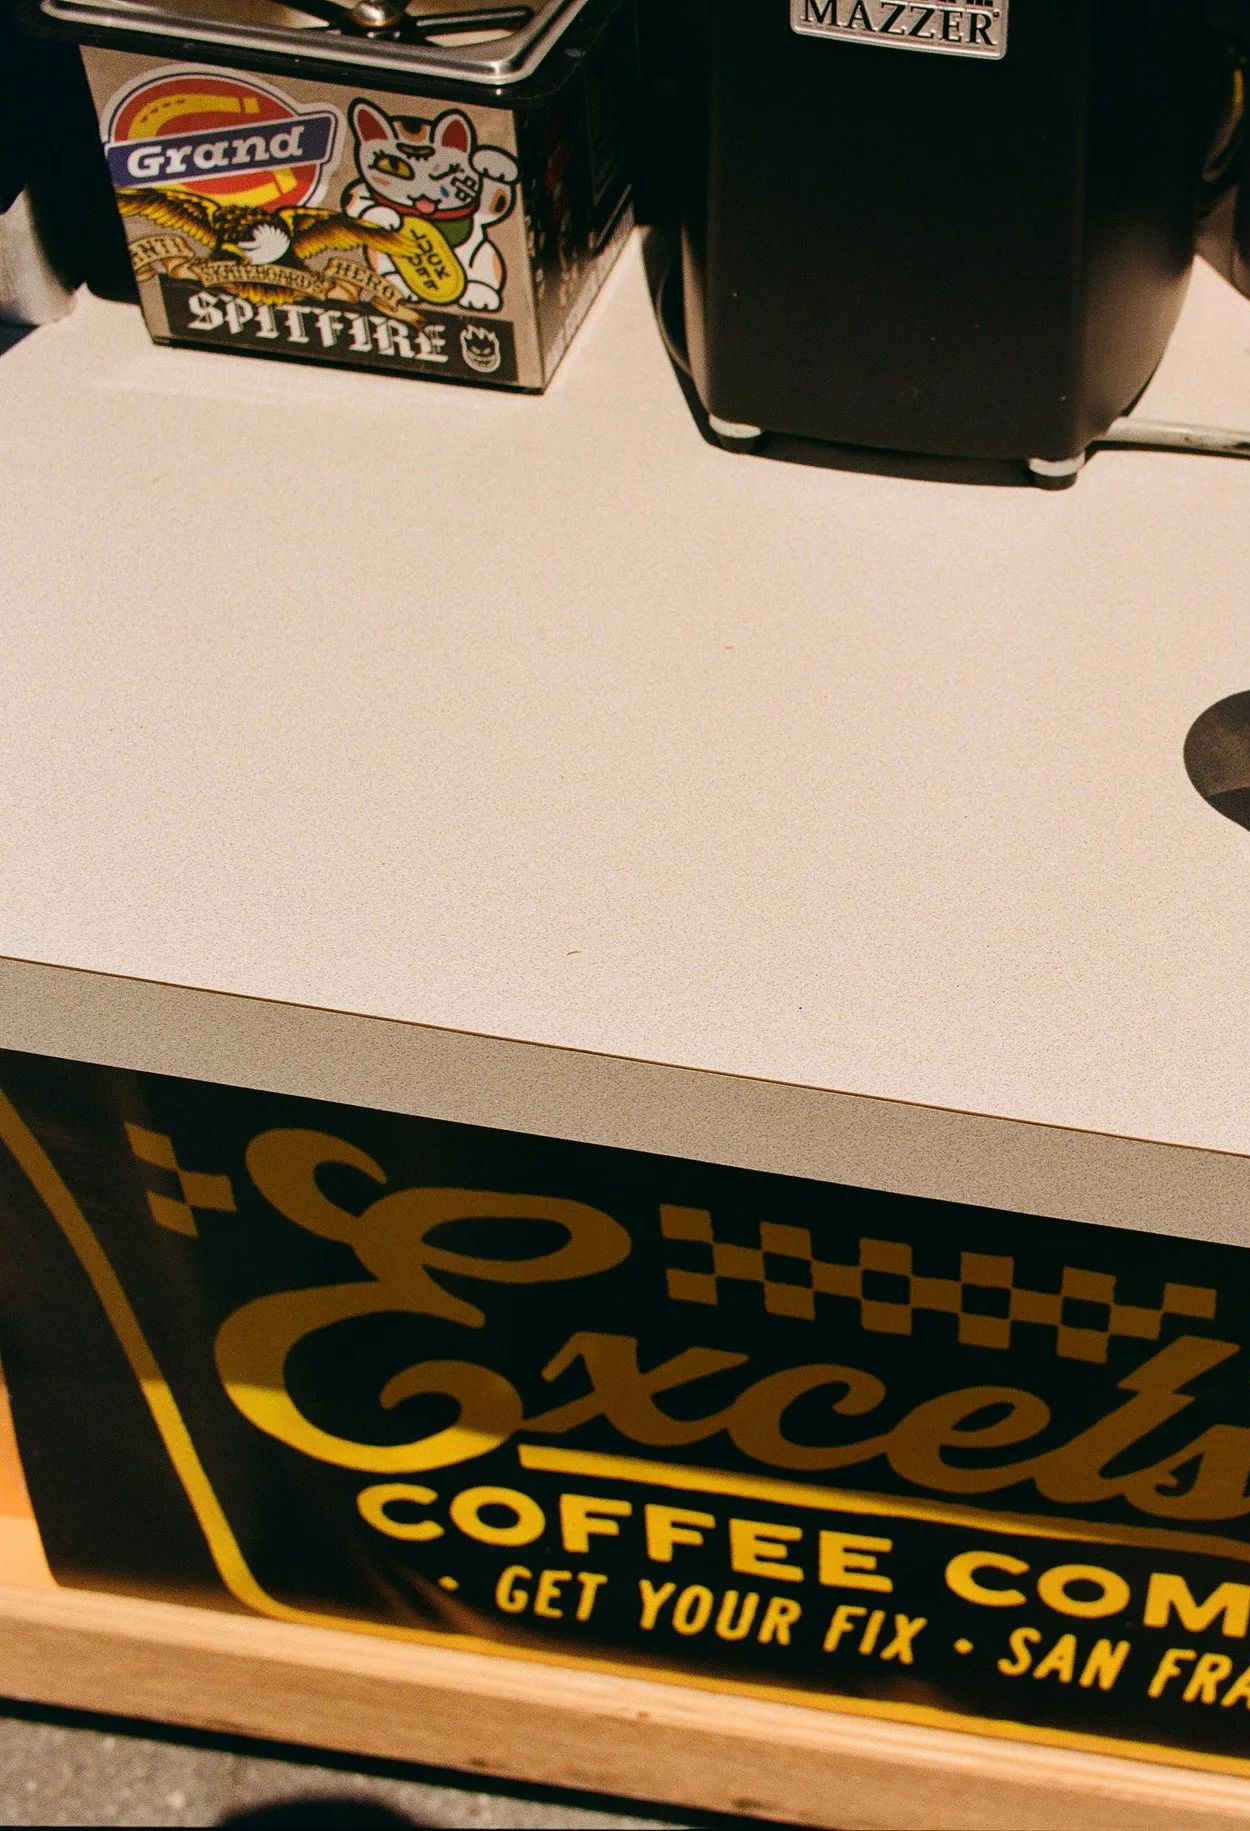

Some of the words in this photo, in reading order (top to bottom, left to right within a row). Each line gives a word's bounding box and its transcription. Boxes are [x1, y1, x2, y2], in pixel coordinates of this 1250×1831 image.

[802, 0, 999, 46] MAZZER
[126, 127, 305, 179] Grand
[334, 261, 397, 300] HERO
[188, 291, 450, 363] SPITFIRE
[356, 1483, 894, 1592] COFFEE
[495, 1565, 608, 1622] GET
[638, 1578, 802, 1646] YOUR
[823, 1605, 928, 1665] FIX
[998, 1625, 1130, 1691] SAN
